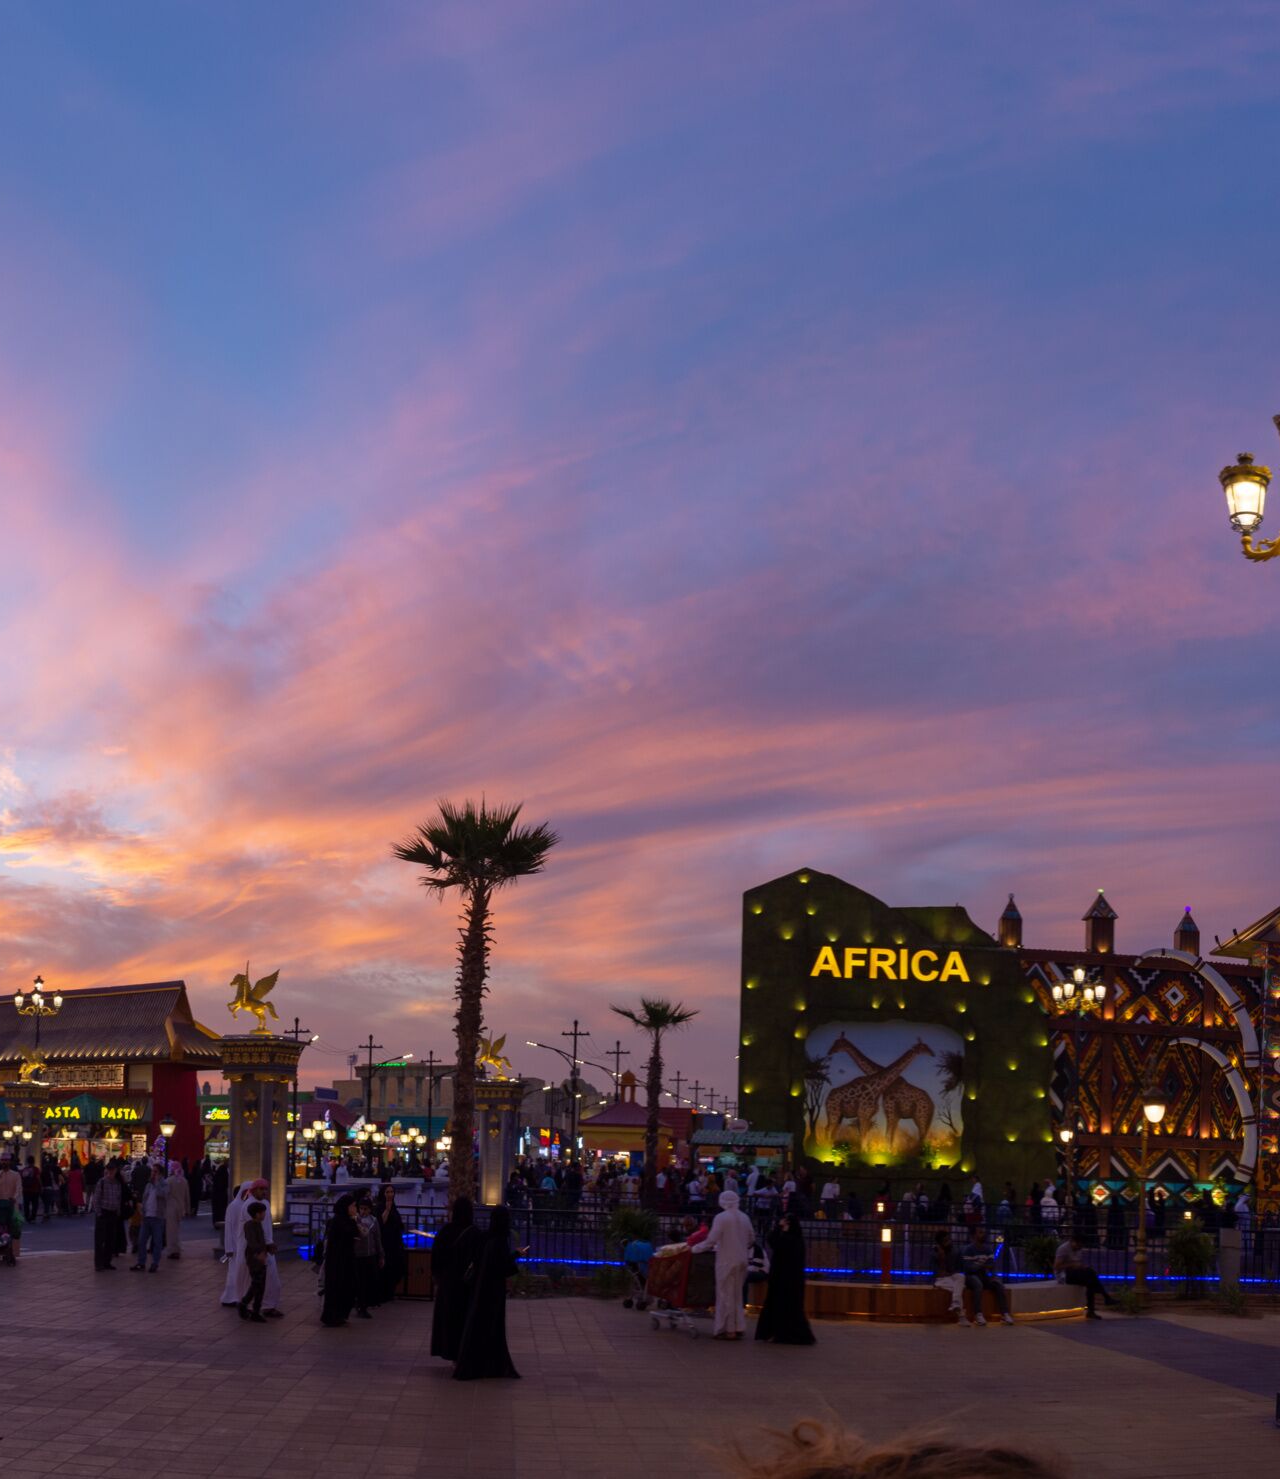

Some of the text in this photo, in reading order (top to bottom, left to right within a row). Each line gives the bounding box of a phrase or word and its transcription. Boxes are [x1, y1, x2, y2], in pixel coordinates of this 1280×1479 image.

[810, 945, 970, 982] AFRICA
[45, 1106, 80, 1119] ASTA
[101, 1106, 138, 1120] PASTA
